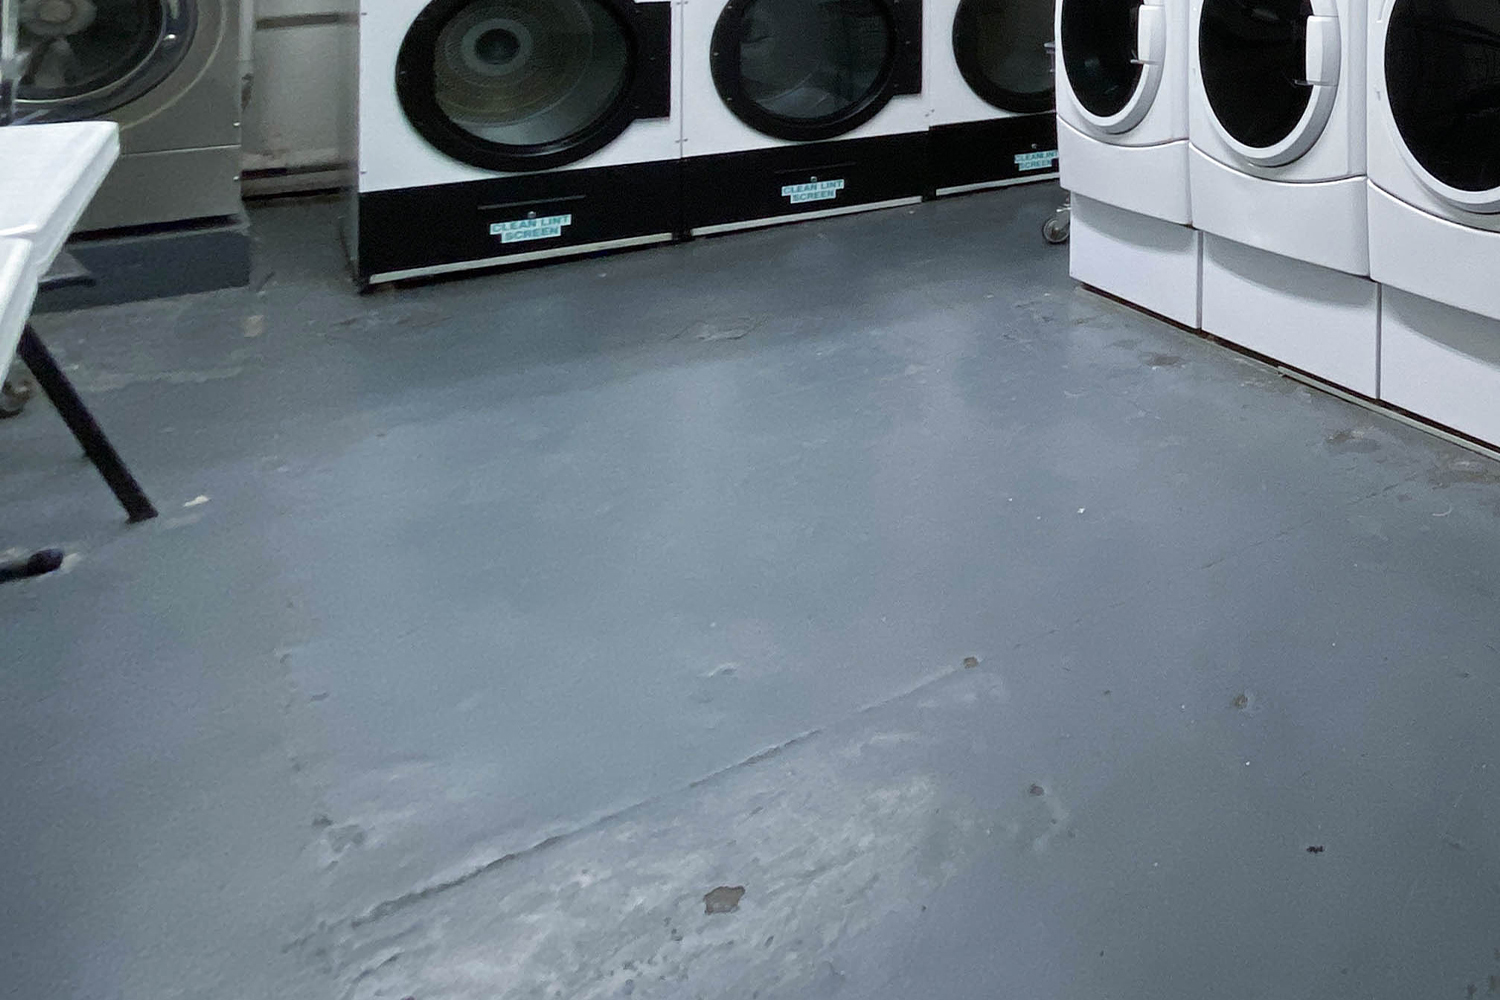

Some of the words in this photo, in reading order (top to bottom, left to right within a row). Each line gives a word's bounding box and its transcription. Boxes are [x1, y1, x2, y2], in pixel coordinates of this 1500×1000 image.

[783, 183, 820, 194] CLEAN
[823, 180, 843, 190] LINT
[792, 189, 835, 202] SCREEN
[493, 218, 537, 232] CLEAN
[540, 215, 571, 227] LINT
[504, 227, 559, 241] SCREEN
